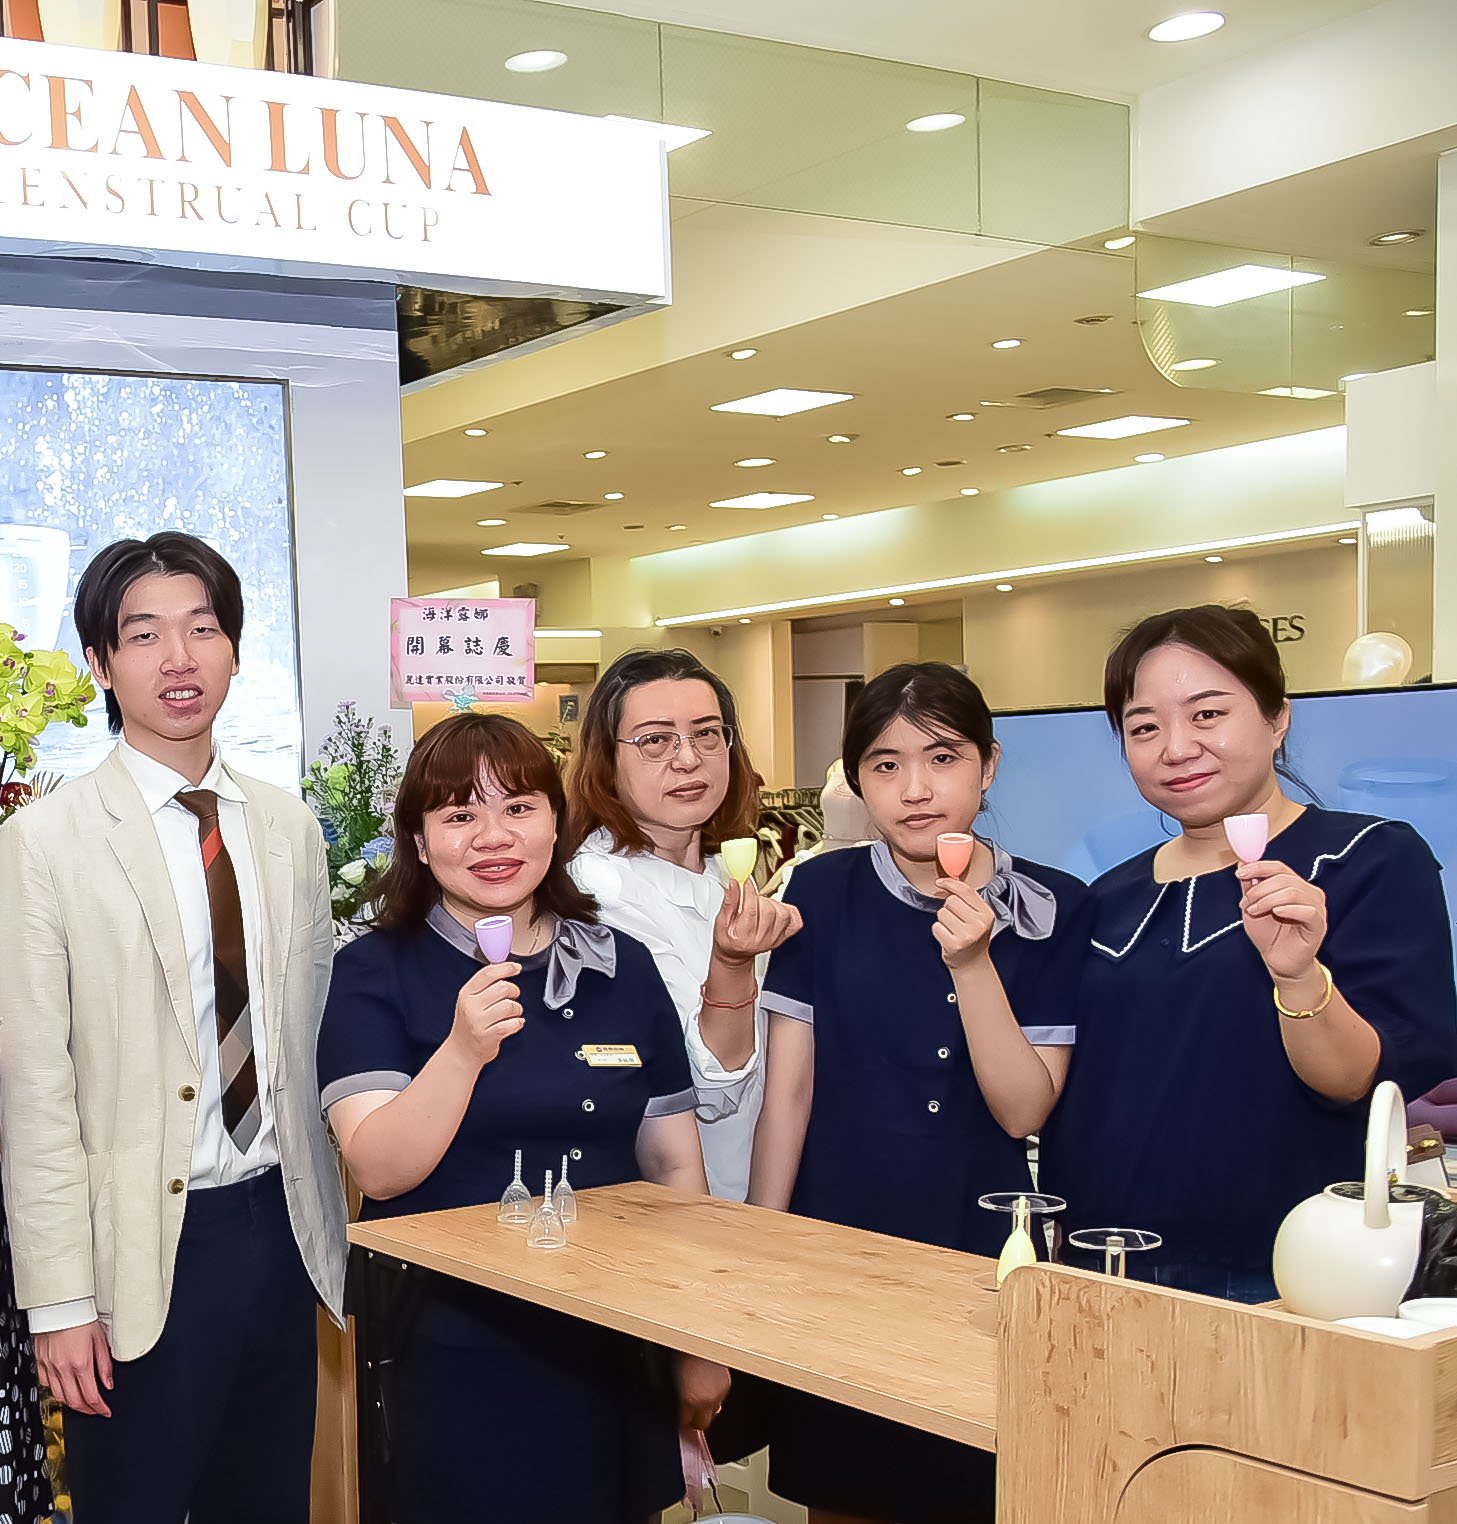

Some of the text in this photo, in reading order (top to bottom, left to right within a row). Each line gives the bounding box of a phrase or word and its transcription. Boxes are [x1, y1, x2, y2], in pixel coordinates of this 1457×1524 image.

[259, 99, 493, 196] LUNA
[347, 199, 440, 242] CUP
[422, 606, 489, 621] 海洋露娜
[406, 635, 513, 656] 開幕誌慶
